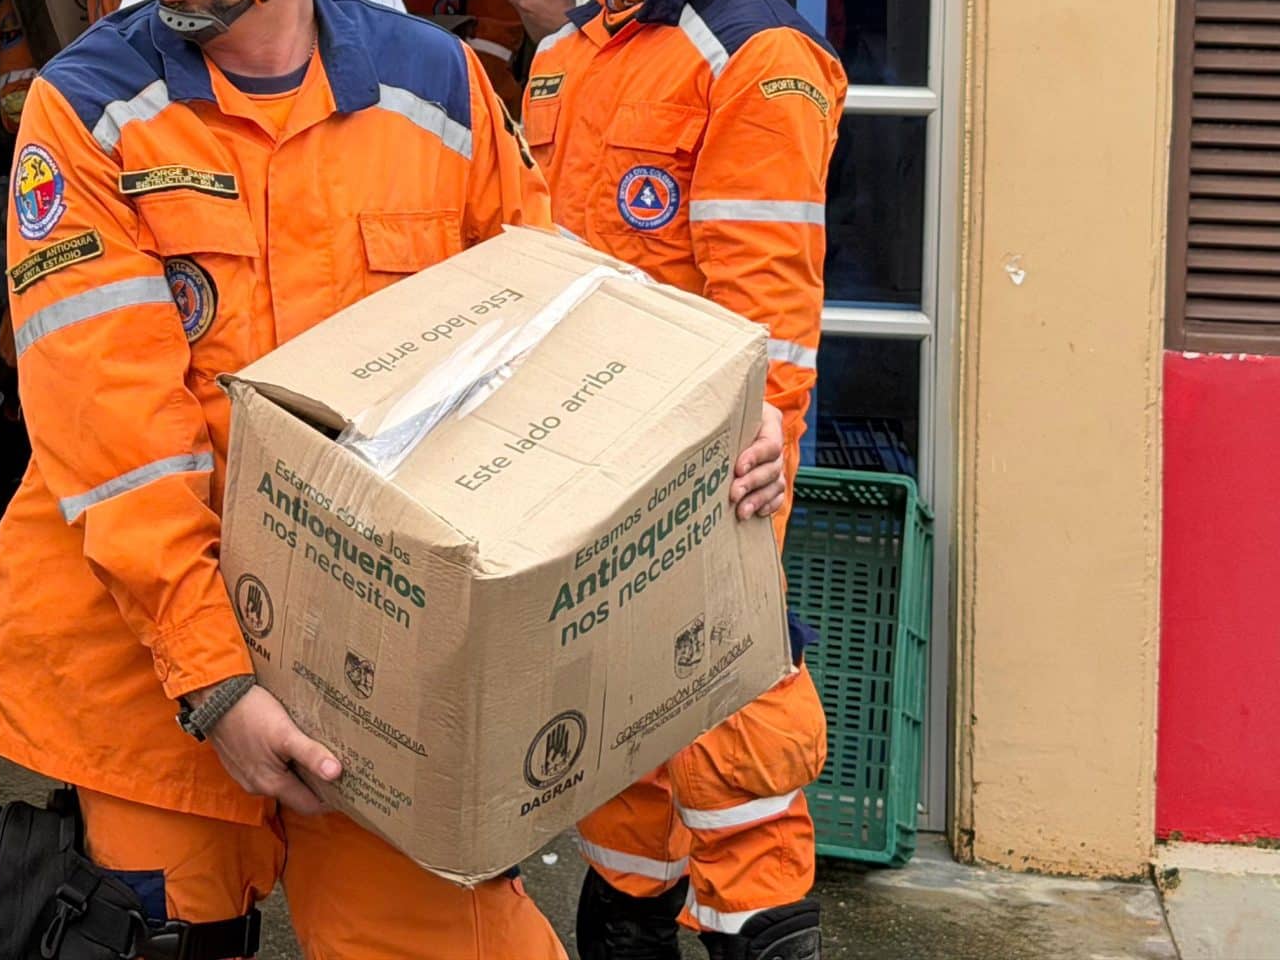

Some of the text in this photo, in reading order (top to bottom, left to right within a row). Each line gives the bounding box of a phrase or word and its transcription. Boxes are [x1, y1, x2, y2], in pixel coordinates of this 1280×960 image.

[148, 168, 183, 179] JORGE
[43, 249, 81, 269] ESTADIO
[46, 235, 93, 258] ANTIOQUIA
[351, 288, 524, 380] Este lado arriba
[454, 360, 627, 491] Este lado arriba
[257, 472, 426, 608] Antioqueños
[388, 529, 410, 565] los
[548, 456, 730, 622] Antioqueños
[574, 439, 721, 570] Estamos donde los
[263, 511, 410, 629] nos necesiten
[562, 502, 722, 647] nos necesiten
[357, 706, 371, 721] DE
[373, 716, 426, 753] ANTIOQUIA
[615, 633, 754, 744] GOBERNACIÓN DE ANTIOQUIA
[520, 770, 584, 817] DAGRAN
